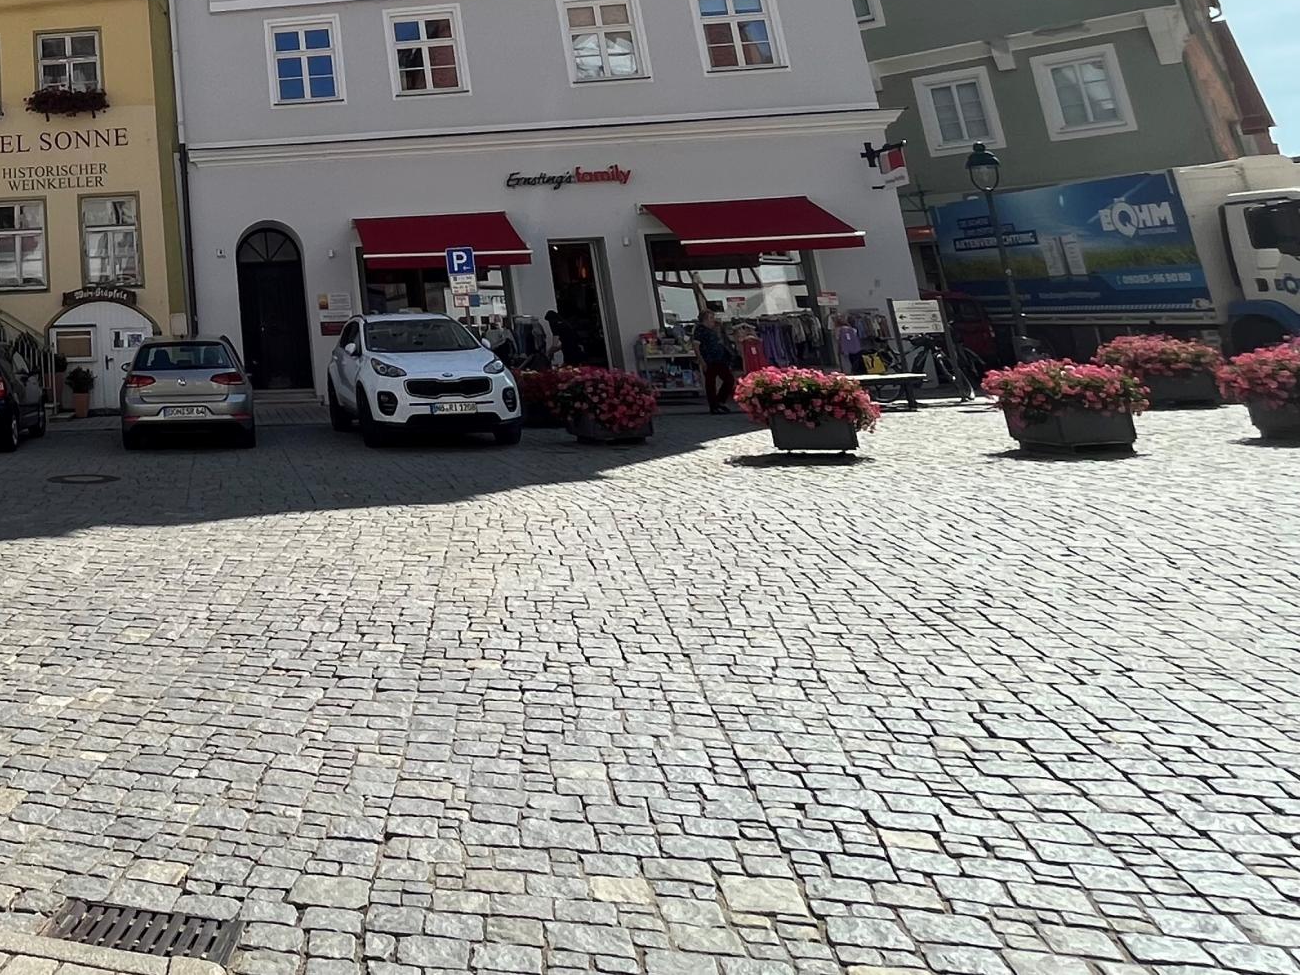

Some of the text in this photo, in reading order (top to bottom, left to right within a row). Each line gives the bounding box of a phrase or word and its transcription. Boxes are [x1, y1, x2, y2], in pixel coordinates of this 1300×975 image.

[40, 128, 129, 152] SONNE
[2, 163, 108, 179] HISTORISCHER
[507, 164, 631, 190] Ernsting's family
[8, 176, 105, 192] WEINKELLER
[452, 252, 467, 272] P
